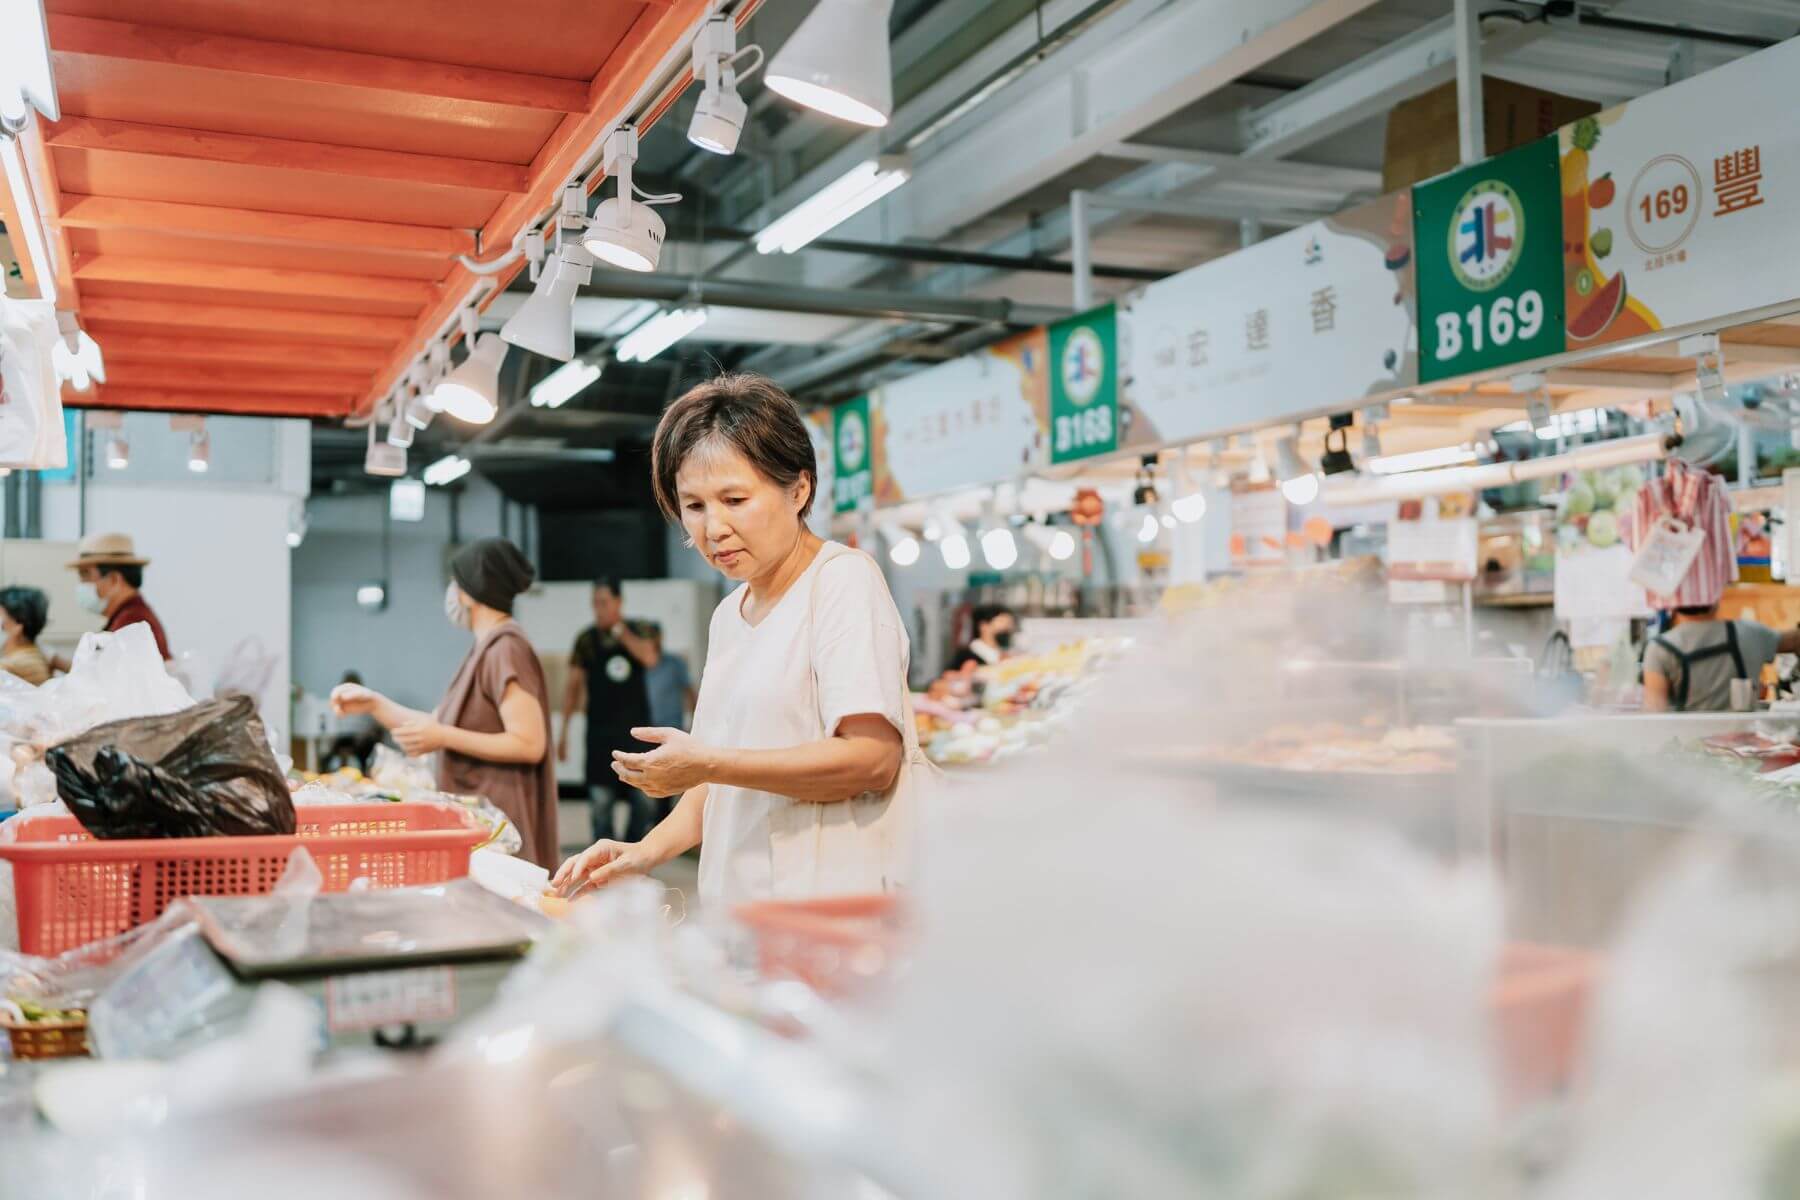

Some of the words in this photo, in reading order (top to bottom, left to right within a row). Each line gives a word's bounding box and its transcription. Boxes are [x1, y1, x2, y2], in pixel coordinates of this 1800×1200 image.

[1639, 184, 1689, 224] 169
[1713, 145, 1765, 217] 豐
[1435, 289, 1544, 361] B169
